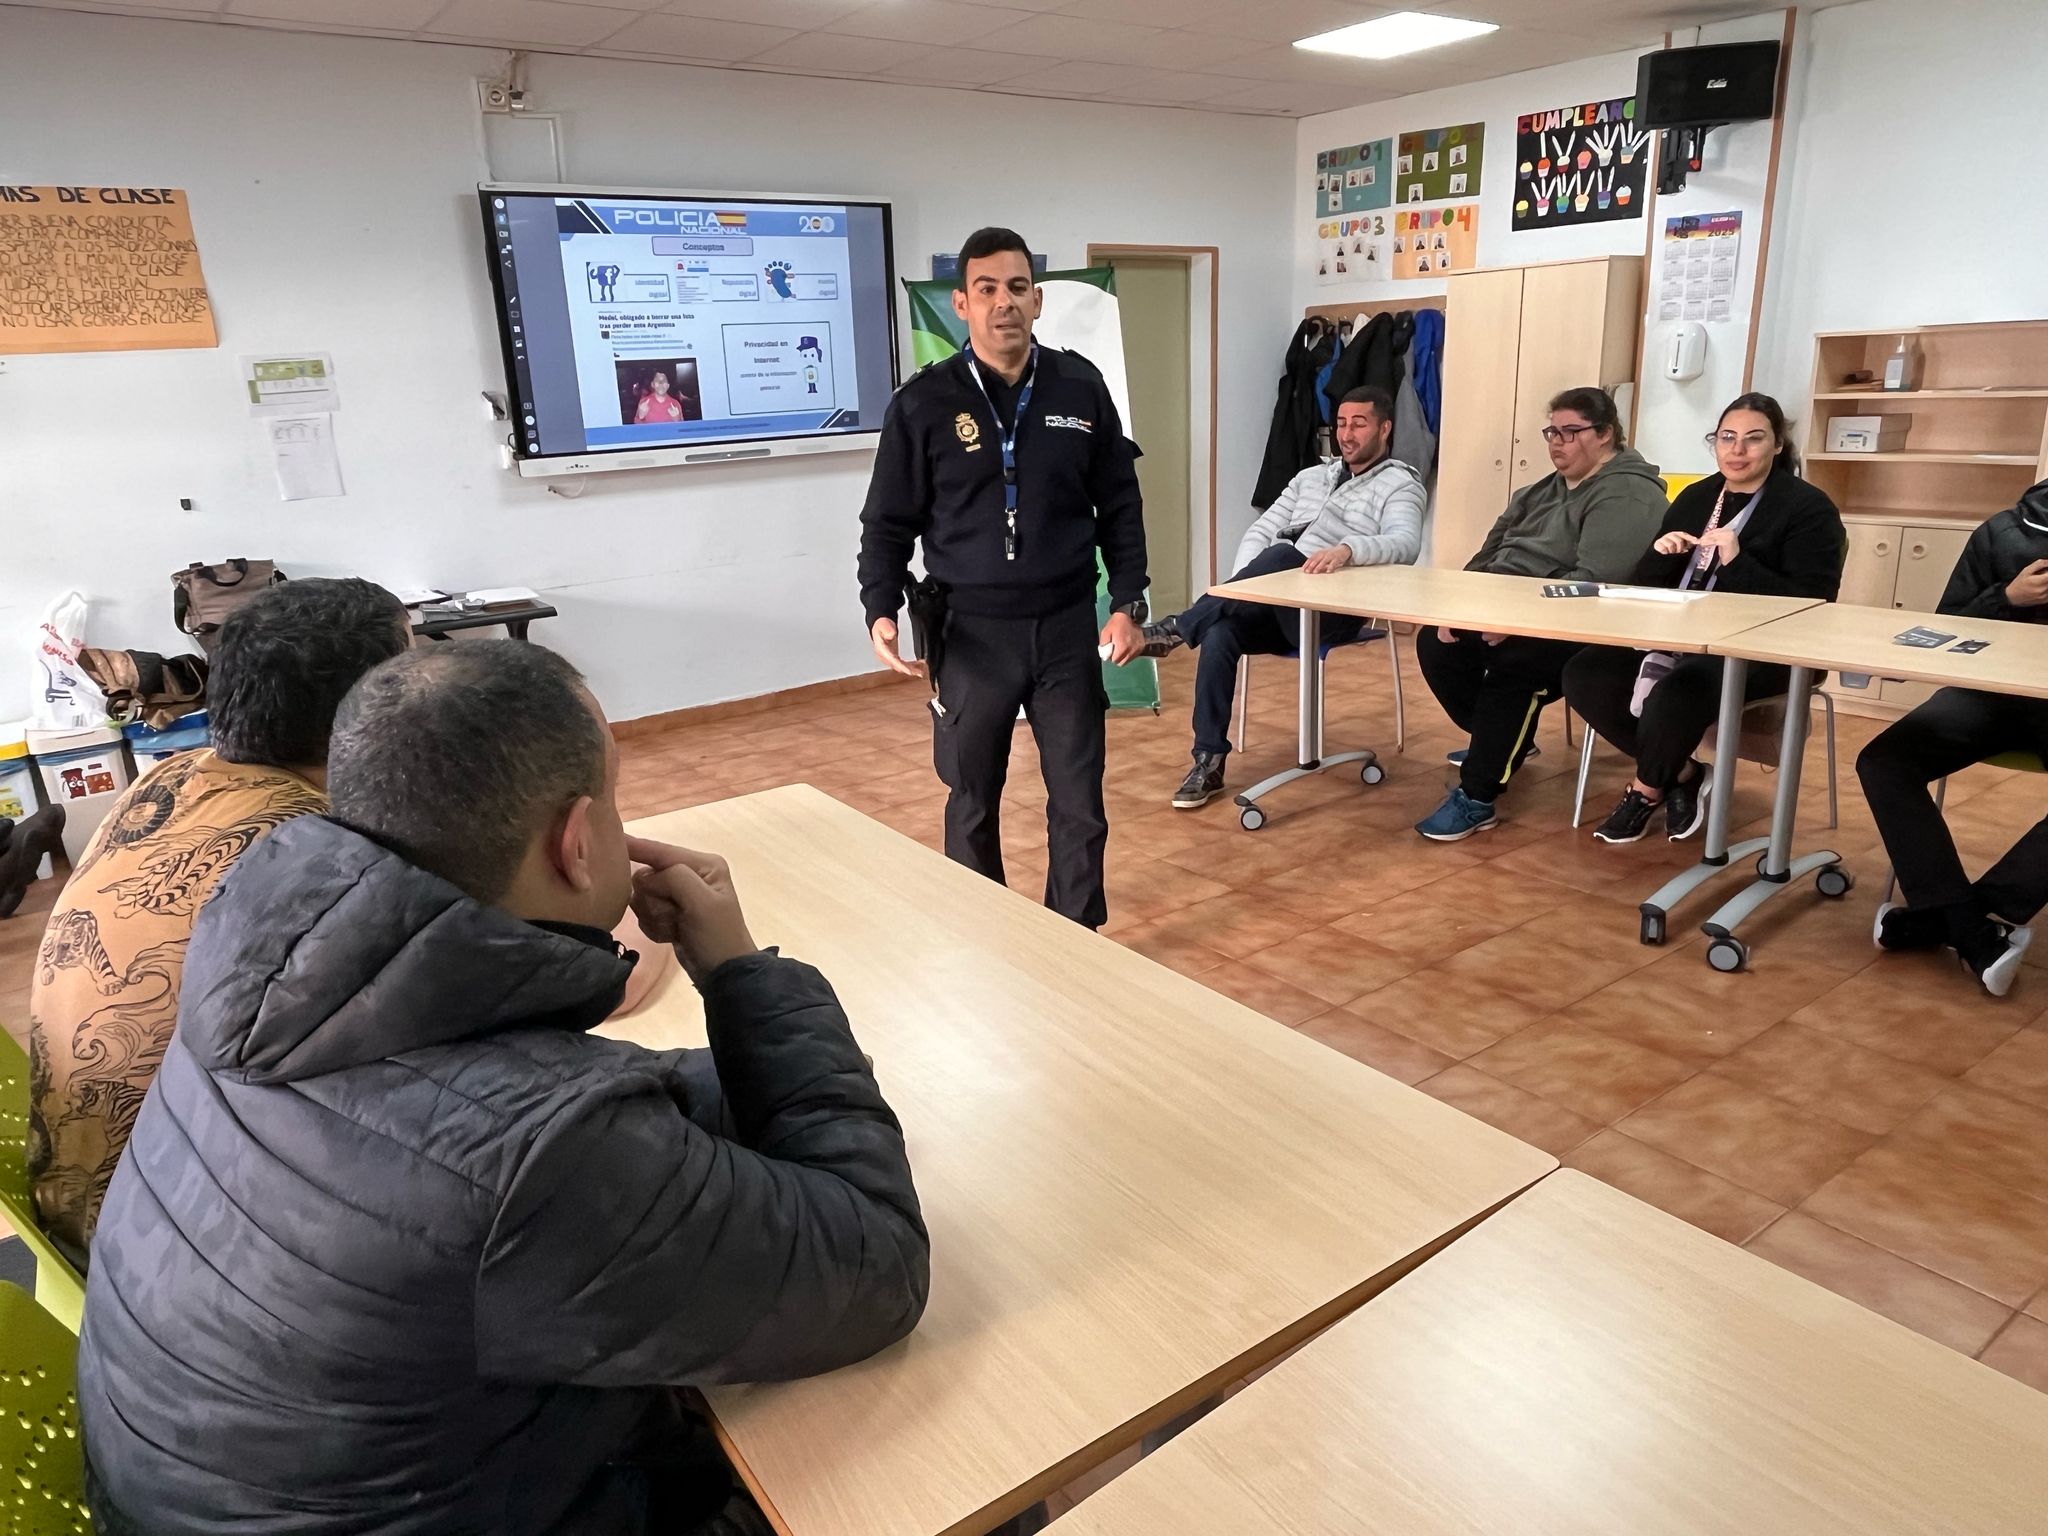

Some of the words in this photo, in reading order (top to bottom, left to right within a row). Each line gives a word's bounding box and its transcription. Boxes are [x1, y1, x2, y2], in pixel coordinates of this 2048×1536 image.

[1317, 144, 1371, 169] GRUPO
[1374, 142, 1383, 161] 1
[57, 187, 91, 203] DE
[99, 188, 175, 204] CLASE
[85, 215, 176, 229] CONDUCTA
[1396, 208, 1455, 230] GRUPO
[1457, 207, 1471, 231] 4
[680, 226, 747, 235] NACIONAL
[1318, 216, 1371, 239] GRUPO
[1374, 216, 1385, 236] 3
[1708, 227, 1735, 237] 2025
[78, 241, 103, 252] LOS
[18, 251, 57, 265] USAR
[150, 252, 188, 265] CLASE
[137, 264, 184, 276] CLASE
[2, 316, 28, 328] NO
[140, 312, 157, 326] EN
[160, 312, 202, 324] CLASE
